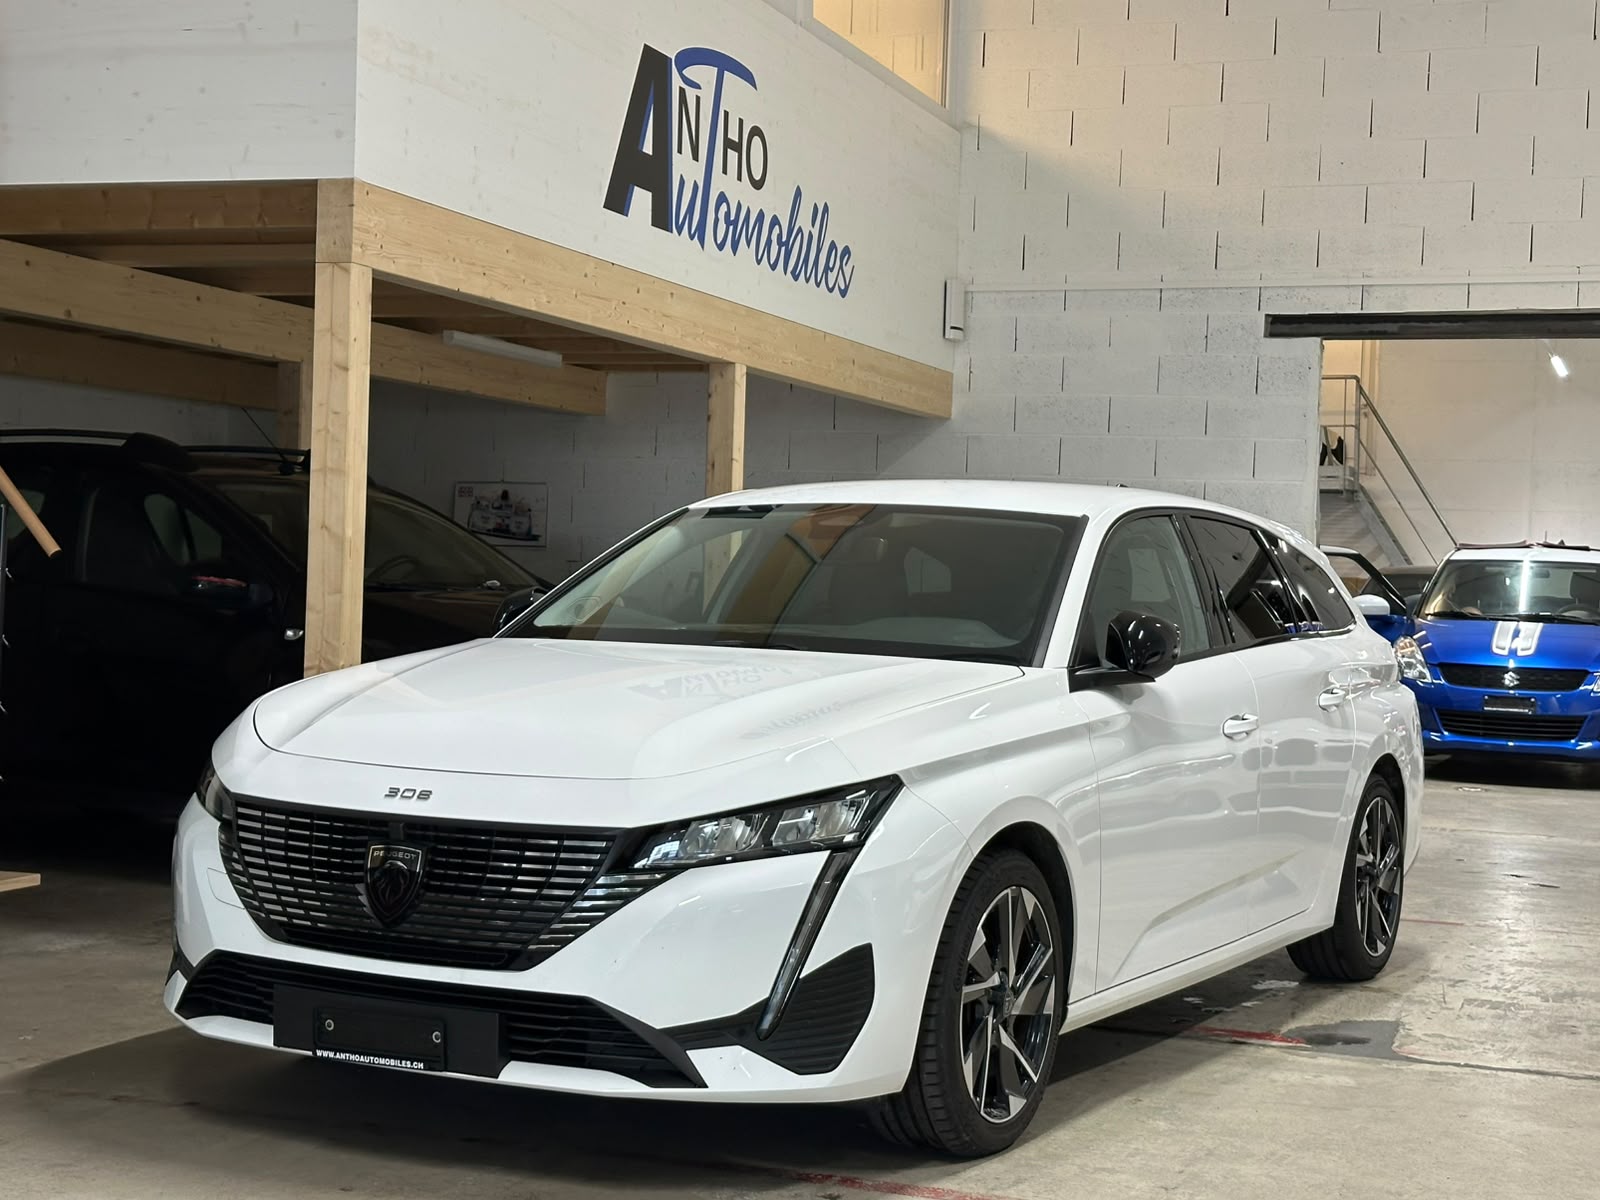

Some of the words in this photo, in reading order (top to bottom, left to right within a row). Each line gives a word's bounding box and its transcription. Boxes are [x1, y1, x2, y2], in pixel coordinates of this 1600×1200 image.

[603, 43, 768, 250] ANTHO
[385, 787, 433, 801] 308
[373, 850, 417, 860] PEUGEOT
[316, 1049, 424, 1069] WWW.ANTHOAUTOMOBILES.CH
